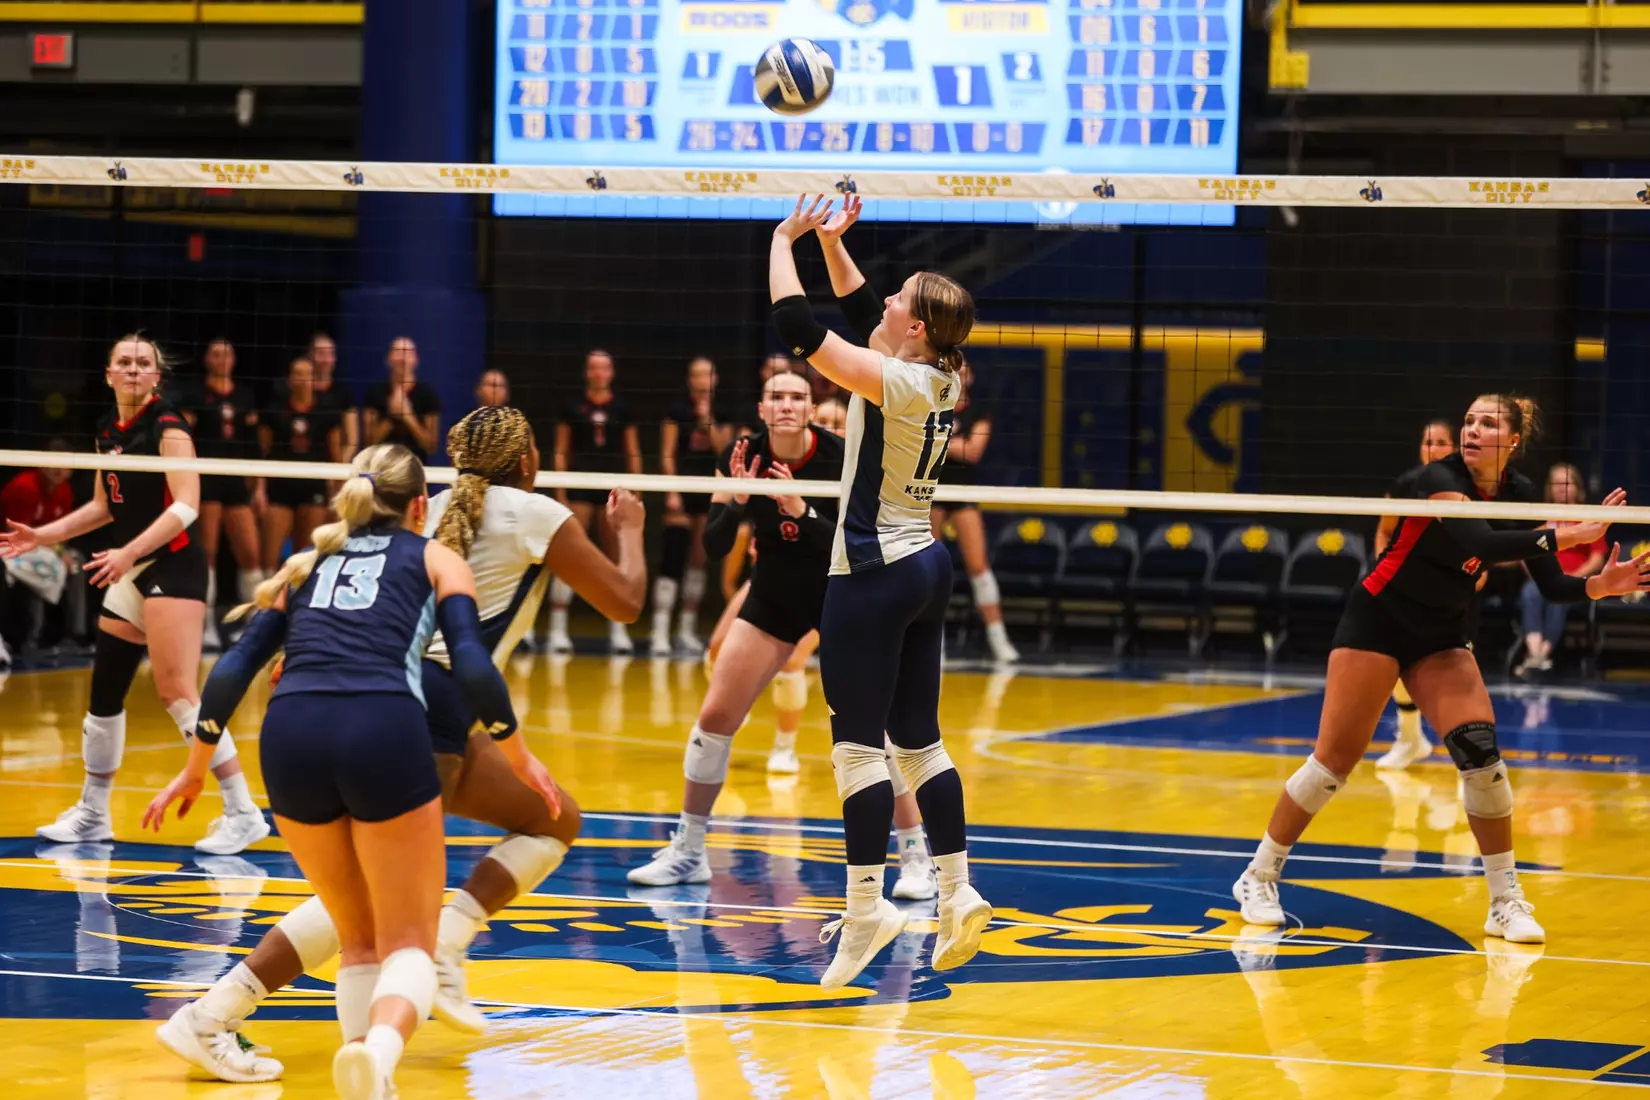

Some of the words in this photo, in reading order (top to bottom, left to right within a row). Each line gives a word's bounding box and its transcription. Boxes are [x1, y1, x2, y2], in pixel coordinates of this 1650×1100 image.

[954, 65, 973, 105] 1
[1140, 118, 1151, 147] 1
[3, 159, 36, 170] SAS
[201, 163, 270, 173] KANSAS
[0, 169, 22, 178] TY
[215, 173, 255, 184] CITY
[439, 168, 510, 178] KANSAS
[684, 172, 757, 183] KANSAS
[455, 178, 495, 188] CITY
[938, 175, 1012, 187] KANSAS
[1198, 179, 1276, 191] KANSAS
[700, 183, 742, 193] CITY
[953, 187, 996, 197] CITY
[1468, 181, 1550, 193] KANSAS
[1214, 190, 1260, 201] CITY
[1486, 193, 1533, 203] CITY
[107, 472, 124, 503] 2
[904, 484, 935, 495] KANS
[308, 553, 387, 611] 13
